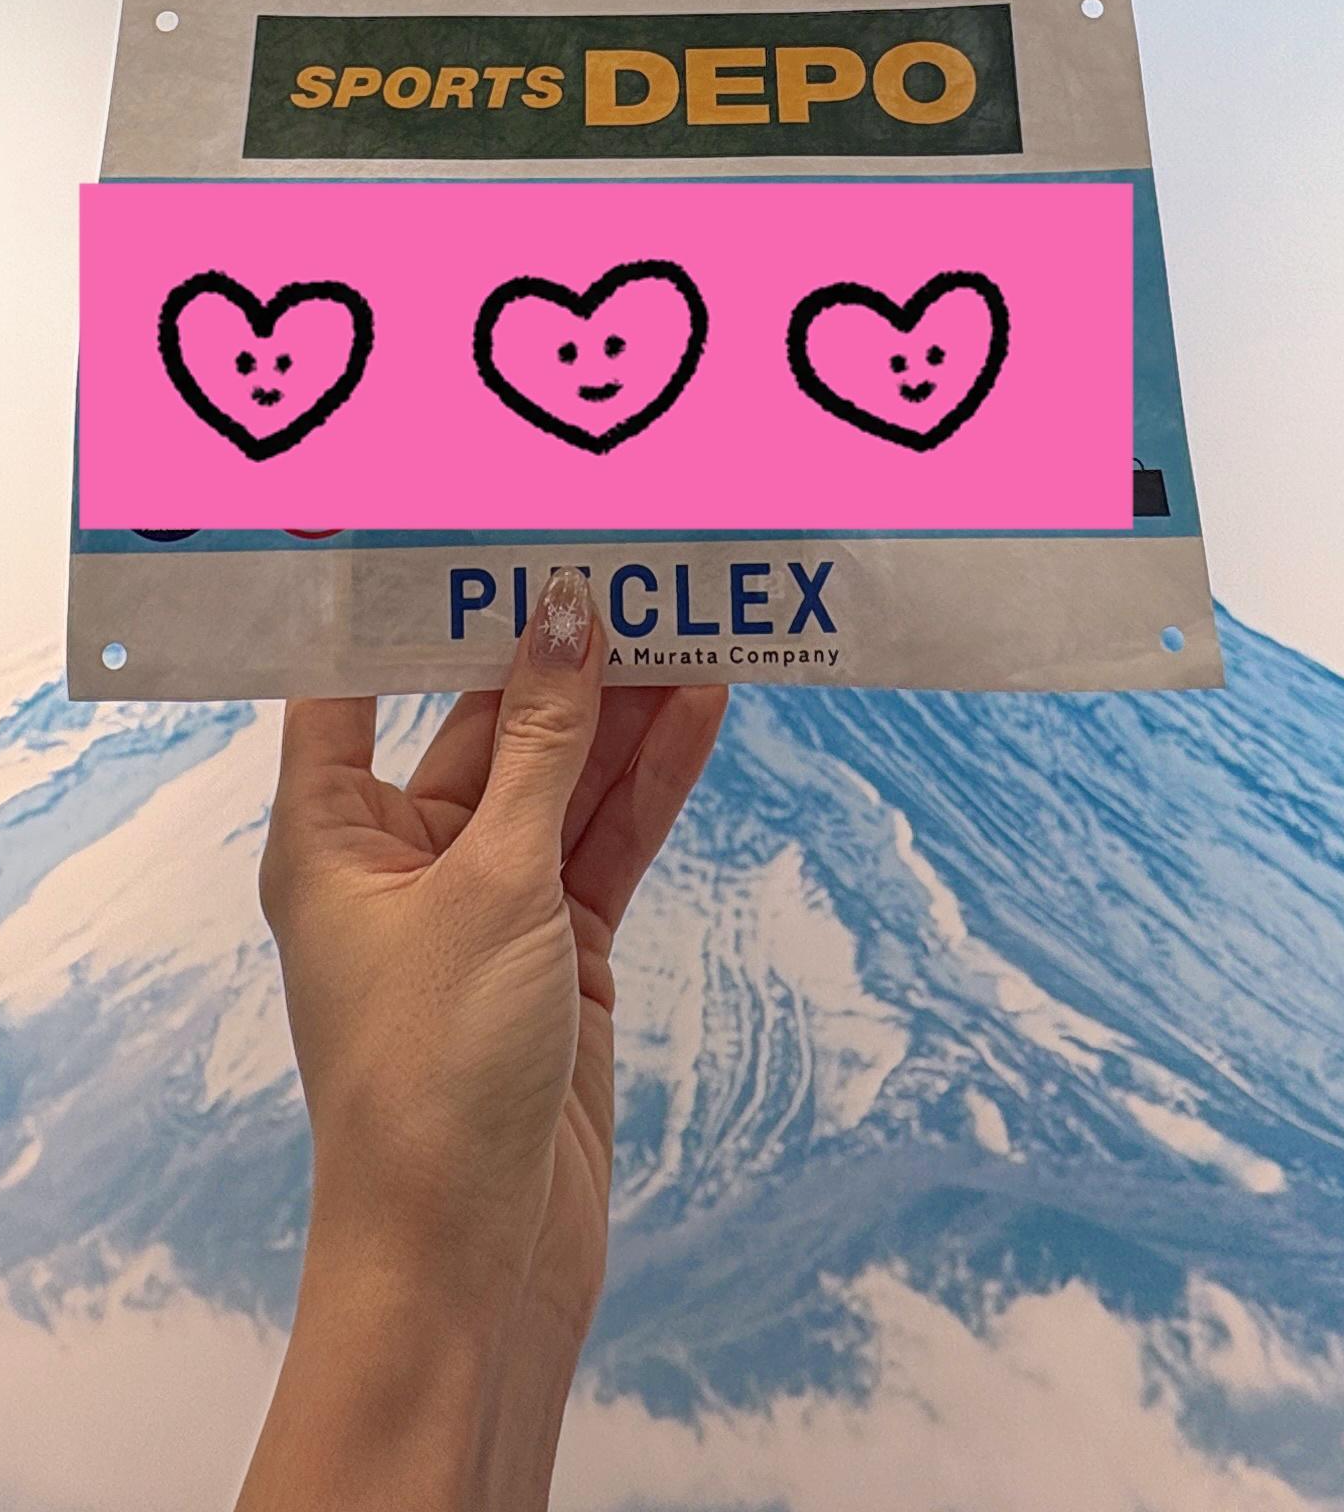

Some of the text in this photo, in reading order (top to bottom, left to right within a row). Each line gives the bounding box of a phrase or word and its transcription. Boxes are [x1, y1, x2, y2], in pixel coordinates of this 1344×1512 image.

[290, 41, 978, 127] SPORTS DEPO
[450, 561, 838, 640] PICLEX
[608, 647, 840, 667] A Murata Company
